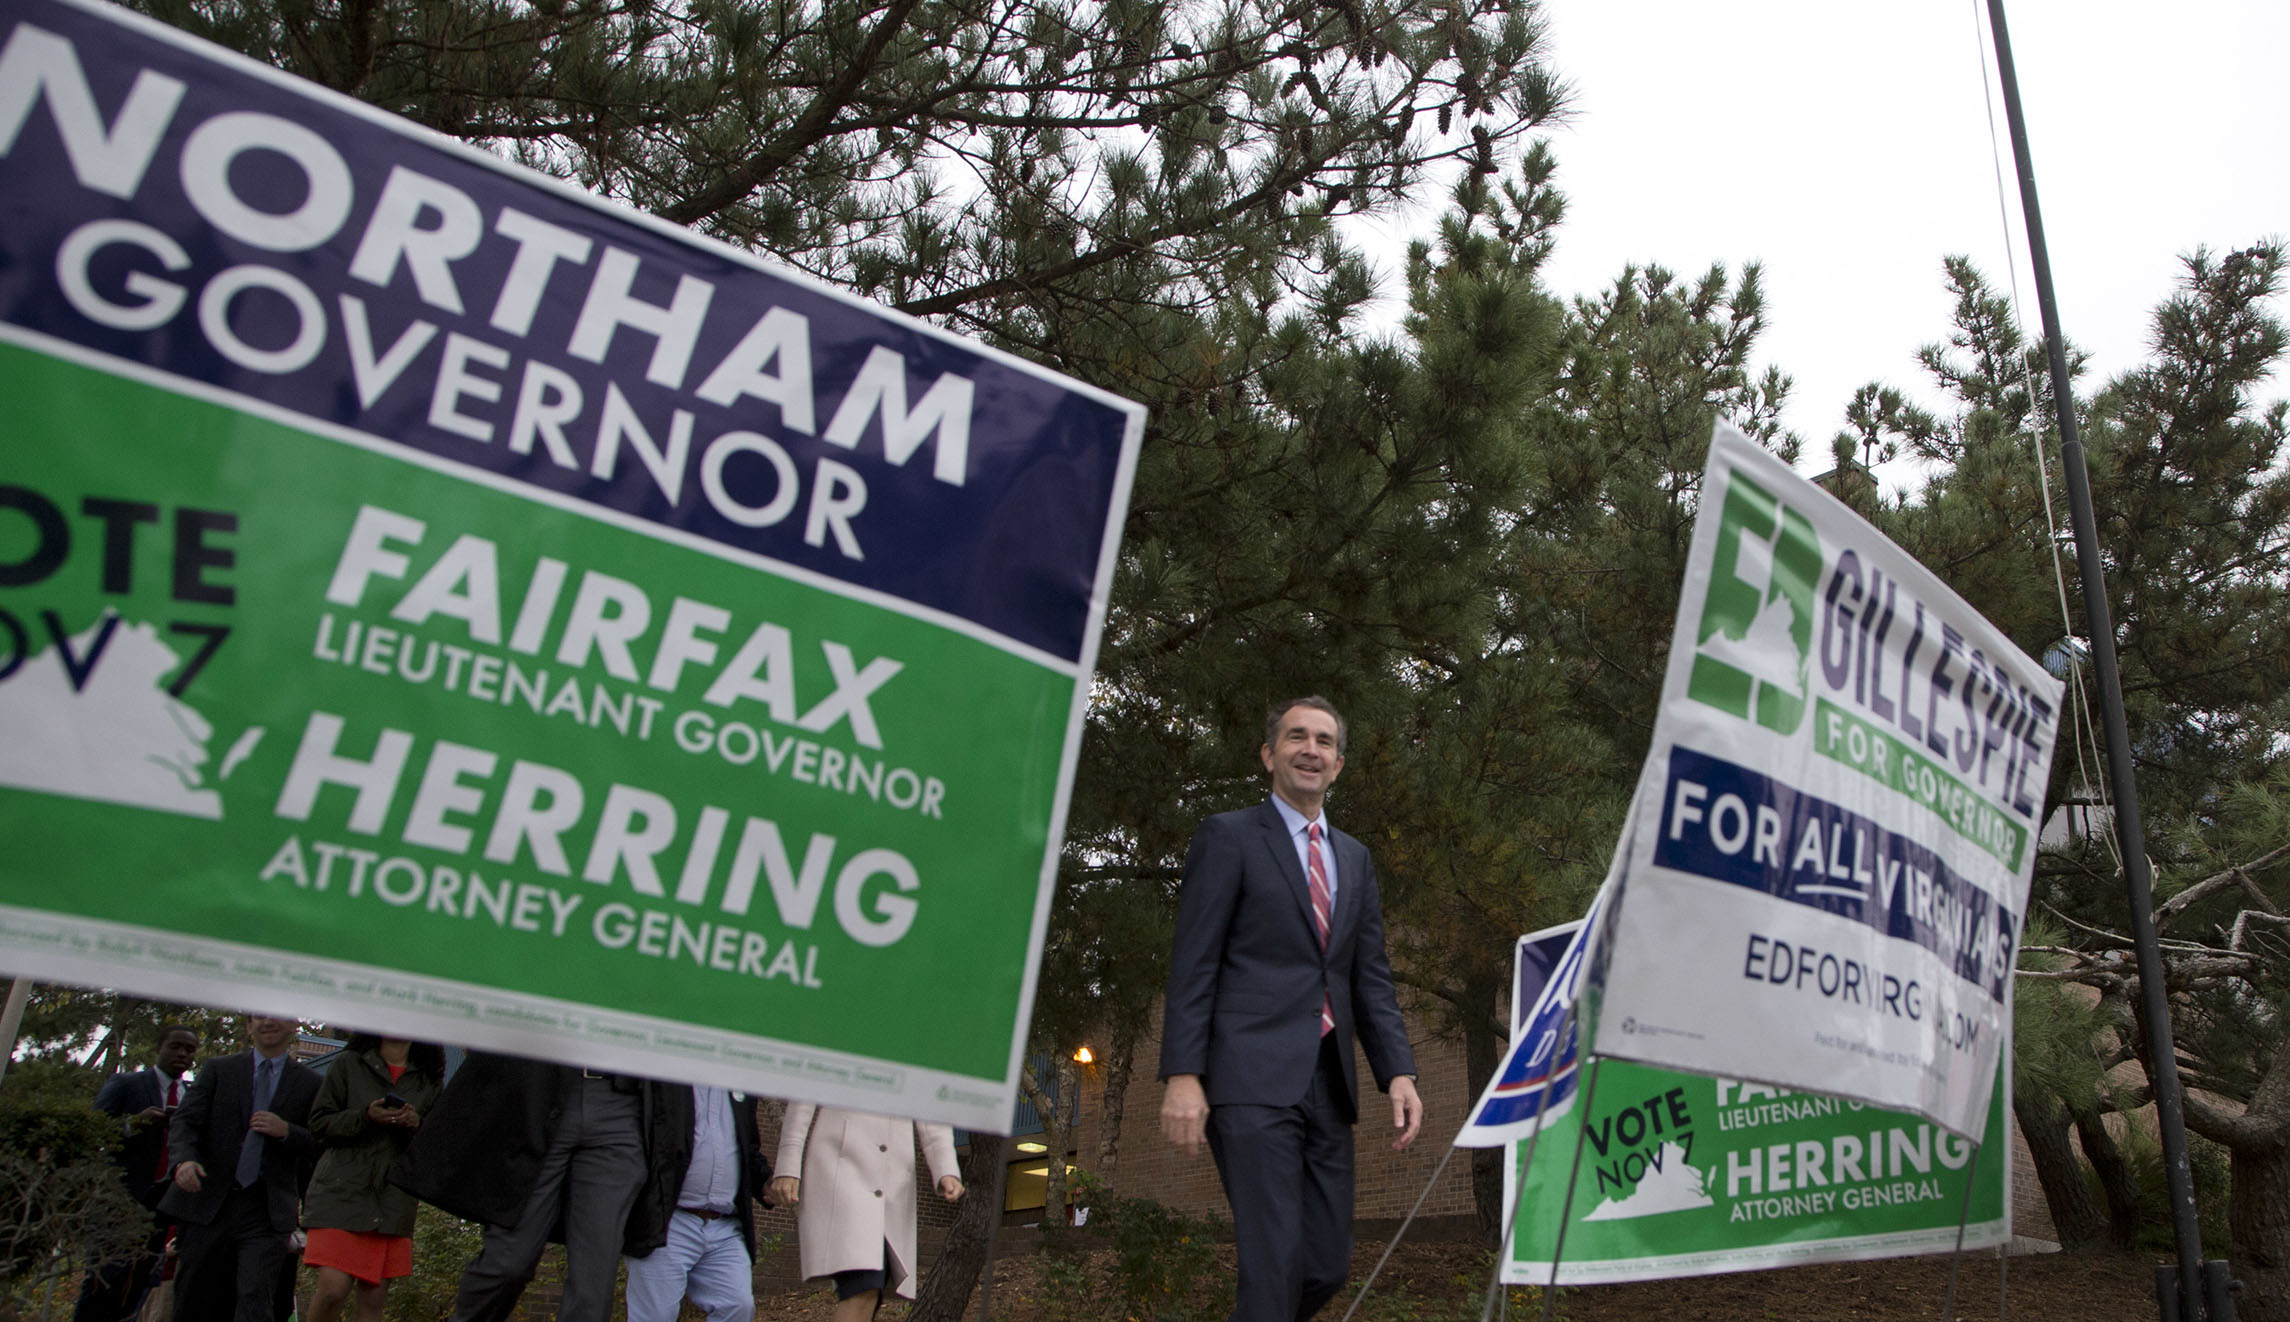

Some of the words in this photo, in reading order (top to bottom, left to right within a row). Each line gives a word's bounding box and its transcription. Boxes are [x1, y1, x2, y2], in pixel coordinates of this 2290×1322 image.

[0, 21, 975, 487] NORTHAM
[55, 218, 868, 562] GOVERNOR
[0, 485, 239, 606] OTE
[325, 505, 906, 750] FAIRFAX
[1821, 549, 2052, 819] GILLESPIE
[313, 613, 664, 740] LIEUTENANT
[674, 710, 946, 819] GOVERNOR
[1827, 711, 1888, 776] FOR
[1903, 755, 2017, 862] GOVERNOR
[274, 710, 921, 947] HERRING
[1669, 779, 1782, 868] FOR
[1792, 817, 1872, 885] ALL
[260, 836, 583, 938] ATTORNEY
[591, 903, 823, 989] GENERAL
[1585, 1086, 1692, 1157] VOTE
[1596, 1141, 1664, 1195] NOV
[1677, 1131, 1694, 1165] 7
[1718, 1096, 1841, 1131] LIEUTENANT
[1727, 1123, 1972, 1197] HERRING
[1730, 1191, 1837, 1223] ATTORNEY
[1842, 1178, 1944, 1210] GENERAL
